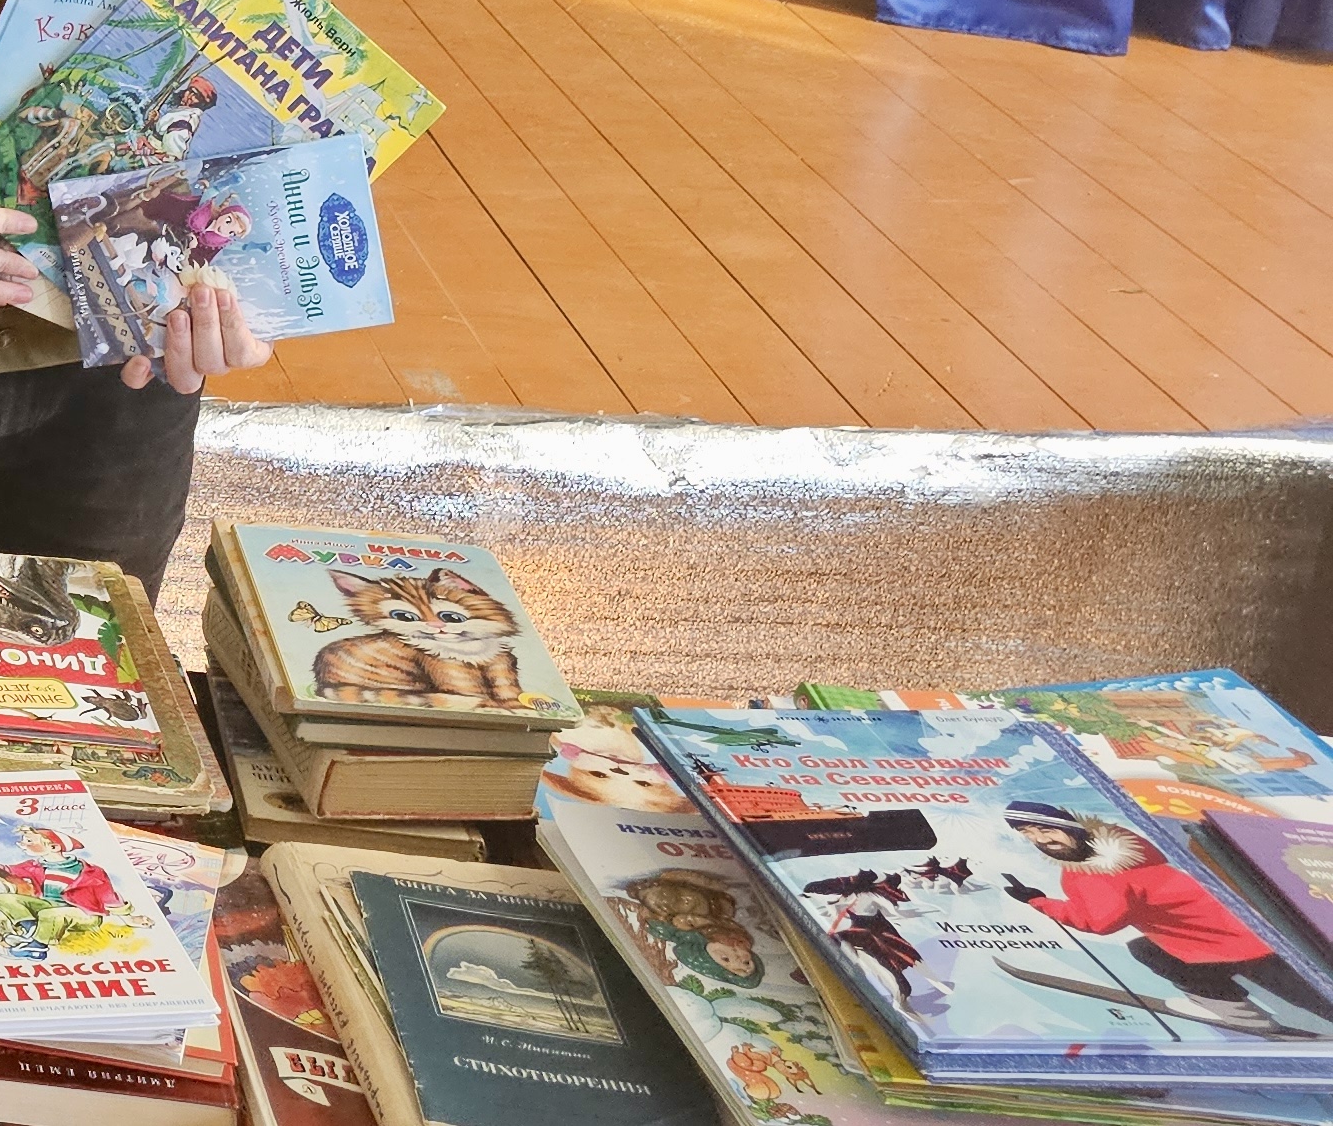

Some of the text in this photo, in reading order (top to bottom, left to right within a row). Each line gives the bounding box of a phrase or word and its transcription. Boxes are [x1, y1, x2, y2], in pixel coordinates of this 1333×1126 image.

[323, 24, 357, 58] Верн
[254, 21, 334, 90] ДЕТИ
[266, 199, 281, 235] Кубок
[282, 169, 325, 321] Анна и Эльза
[327, 224, 345, 261] СЕРДЦЕ
[333, 210, 359, 271] ХОЛОДНОЕ
[263, 543, 417, 572] МУРКА
[366, 543, 470, 564] КИСКА
[935, 714, 1005, 725] Олег Бундур
[733, 754, 1011, 772] Кто был первым
[778, 772, 1000, 789] на Северном
[16, 797, 86, 816] 3 класс
[839, 791, 970, 804] полюсе
[1154, 784, 1253, 814] МИХАЛКОВ
[616, 823, 717, 839] сказки
[394, 877, 458, 897] КНИГА
[464, 888, 490, 901] ЗА
[937, 919, 1034, 936] История
[937, 937, 1065, 952] покорения
[87, 1069, 177, 1089] ДМИТРИЙ
[452, 1055, 653, 1097] СТИХОТВОРЕНИЯ
